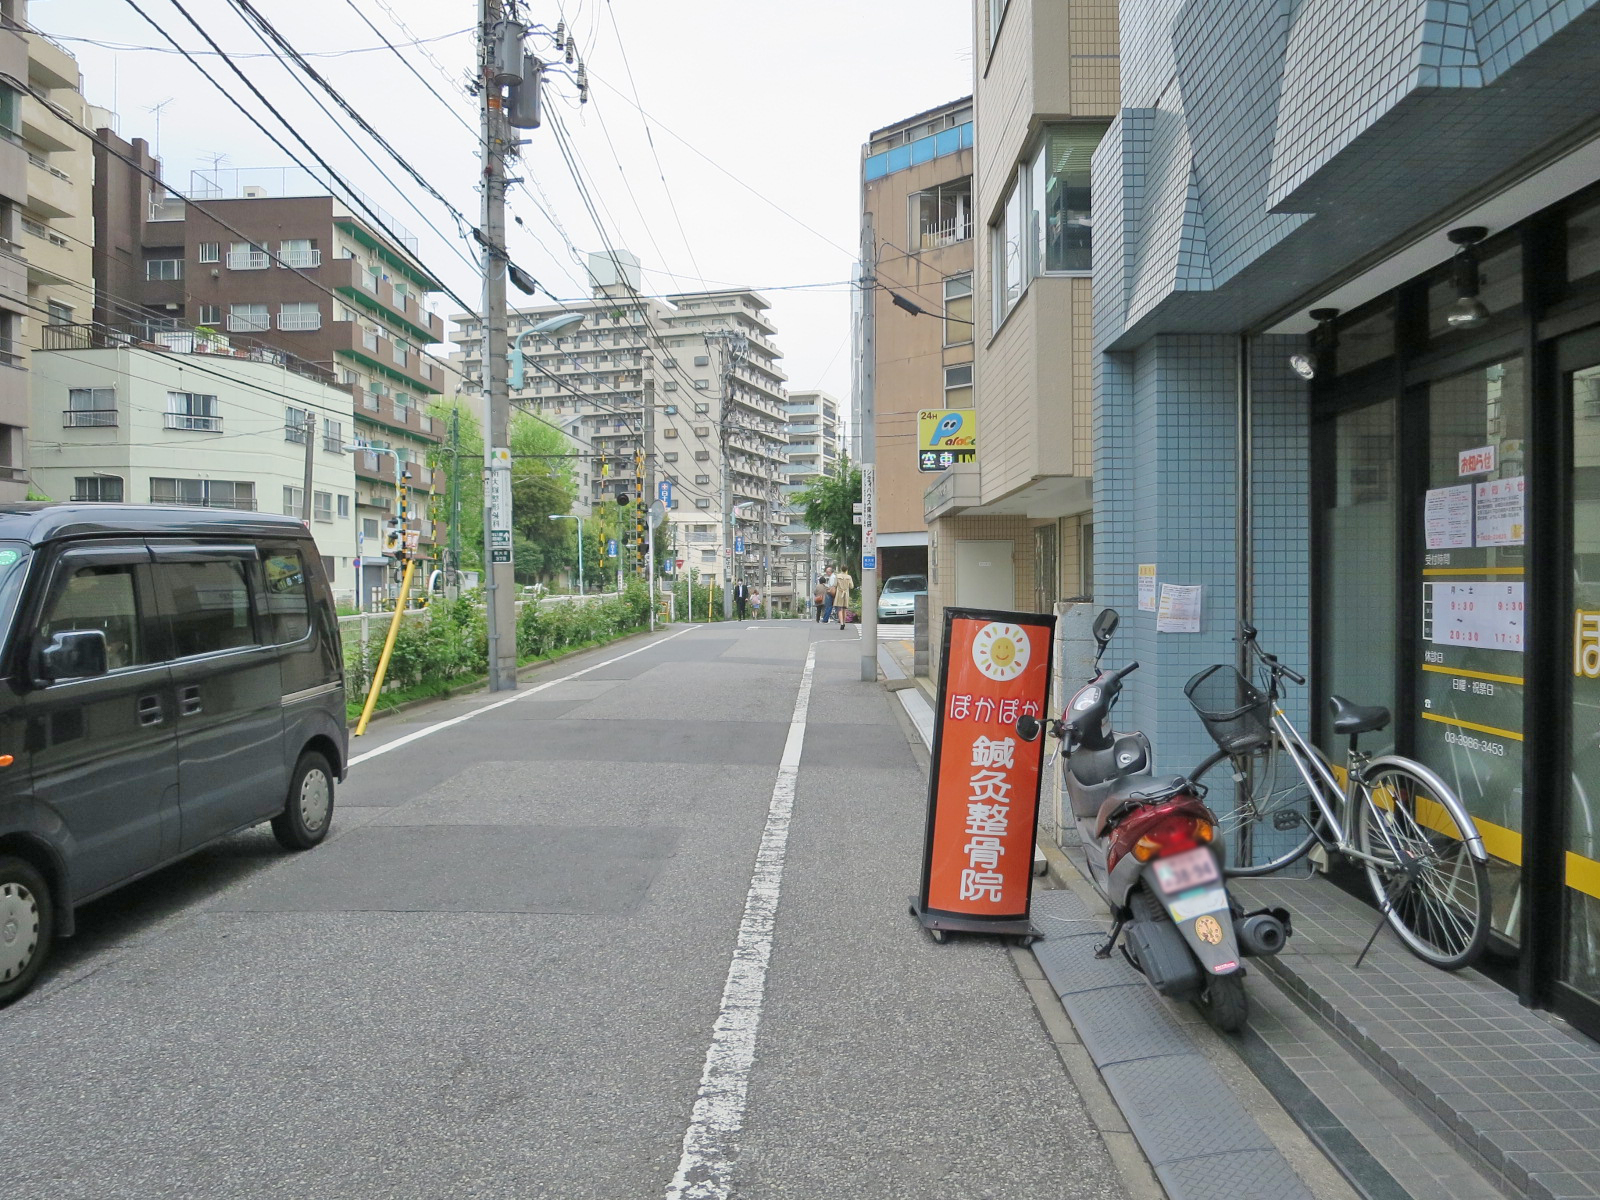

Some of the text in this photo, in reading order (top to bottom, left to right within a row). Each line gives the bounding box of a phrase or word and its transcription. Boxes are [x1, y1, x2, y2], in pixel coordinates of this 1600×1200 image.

[920, 411, 938, 420] 24H
[921, 451, 953, 469] 空車
[1460, 452, 1492, 474] お知らせ
[1424, 553, 1451, 566] 受付時間
[1450, 601, 1474, 611] 9:30
[1497, 601, 1524, 611] 9:30
[1449, 630, 1479, 642] 20:30
[1494, 632, 1524, 645] 17:3
[949, 693, 1040, 726] ぽかぽか
[1444, 730, 1504, 757] 03-3986-3453
[958, 734, 1016, 903] 鍼灸整骨院
